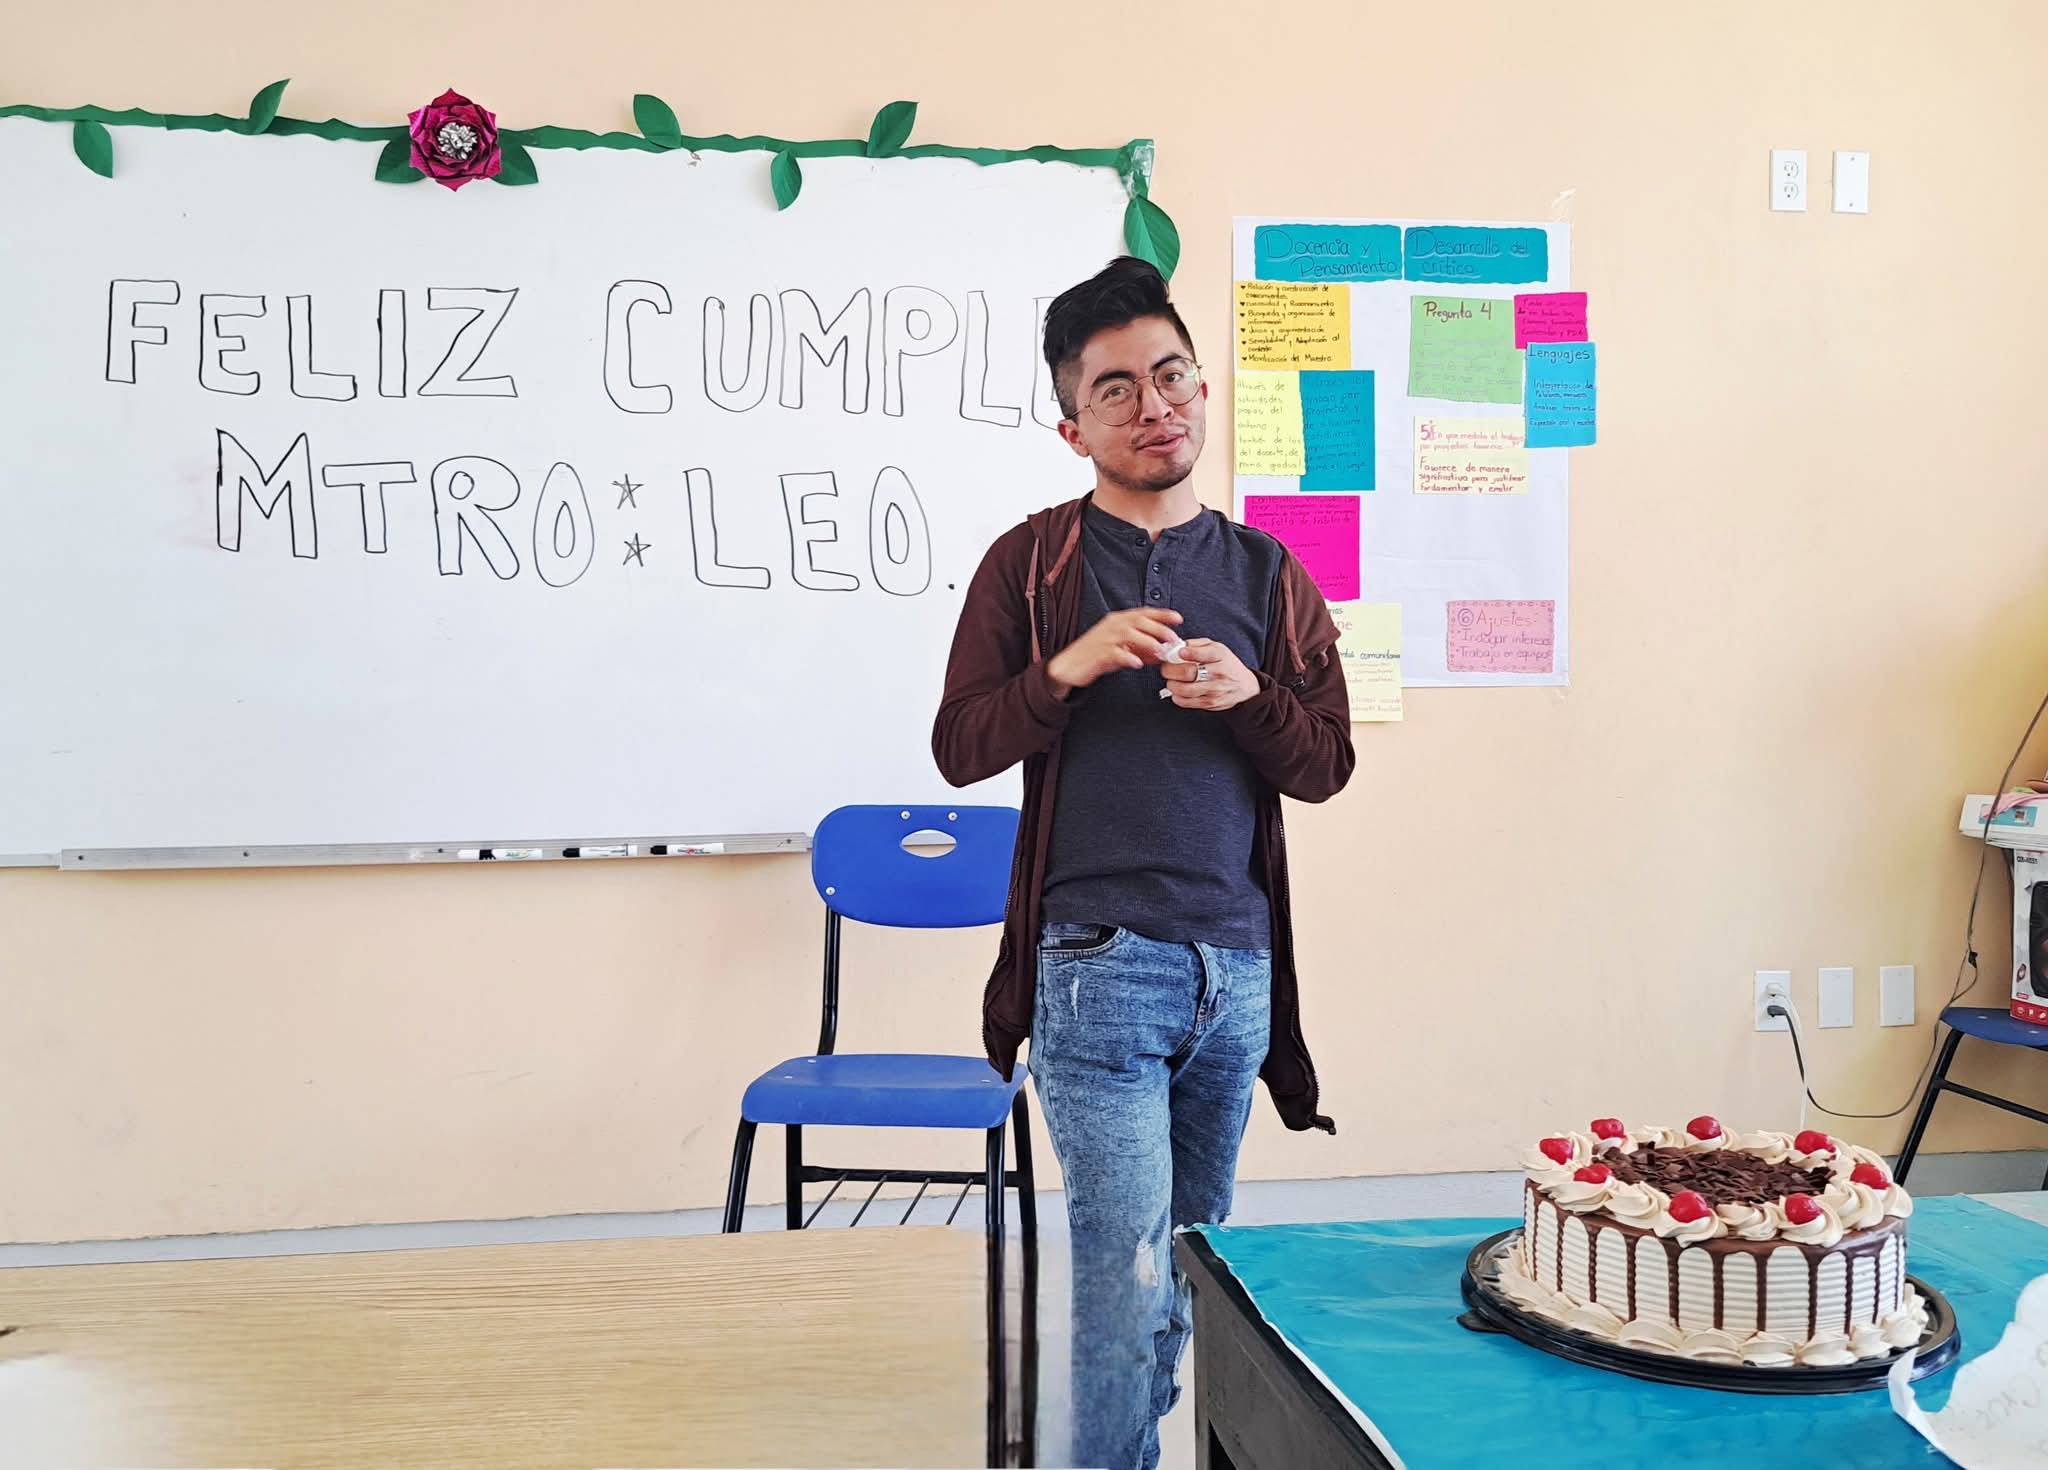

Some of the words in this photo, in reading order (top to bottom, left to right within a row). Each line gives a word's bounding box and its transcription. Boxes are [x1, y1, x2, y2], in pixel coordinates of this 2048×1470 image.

[1258, 229, 1350, 259] Docencia
[1408, 229, 1500, 256] Desarrollo
[1291, 249, 1397, 277] Pensamiento
[1423, 301, 1473, 323] Pregunta
[1480, 301, 1492, 320] 4
[105, 279, 520, 402] FELIZ
[1528, 344, 1590, 364] Lenguajes
[1420, 456, 1457, 473] Favorece
[1465, 462, 1476, 473] de
[1480, 465, 1511, 473] manera
